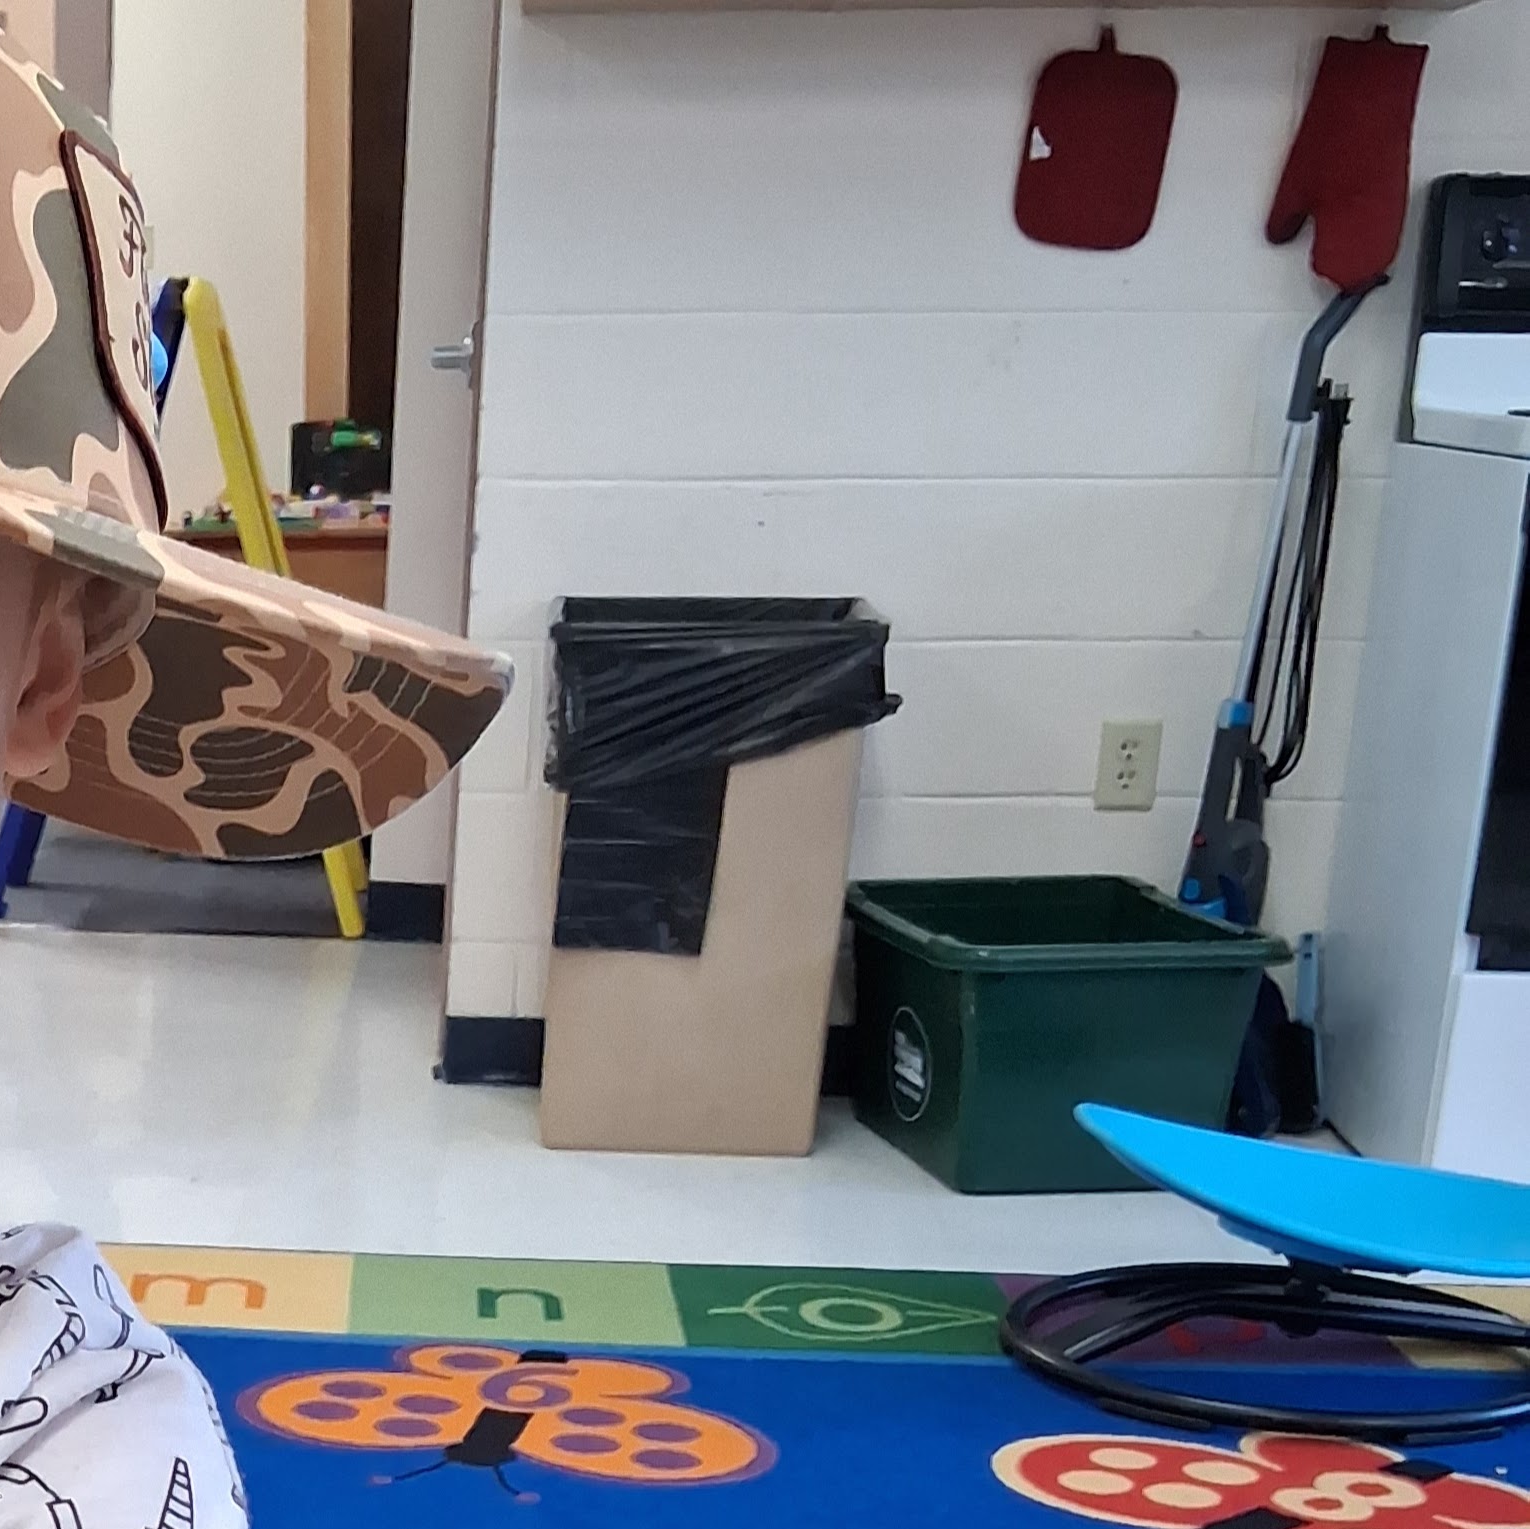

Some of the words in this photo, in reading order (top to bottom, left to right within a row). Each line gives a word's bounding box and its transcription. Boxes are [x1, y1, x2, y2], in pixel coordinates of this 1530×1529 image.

[131, 1273, 267, 1310] m
[476, 1286, 565, 1322] n
[1270, 1469, 1428, 1522] 8
